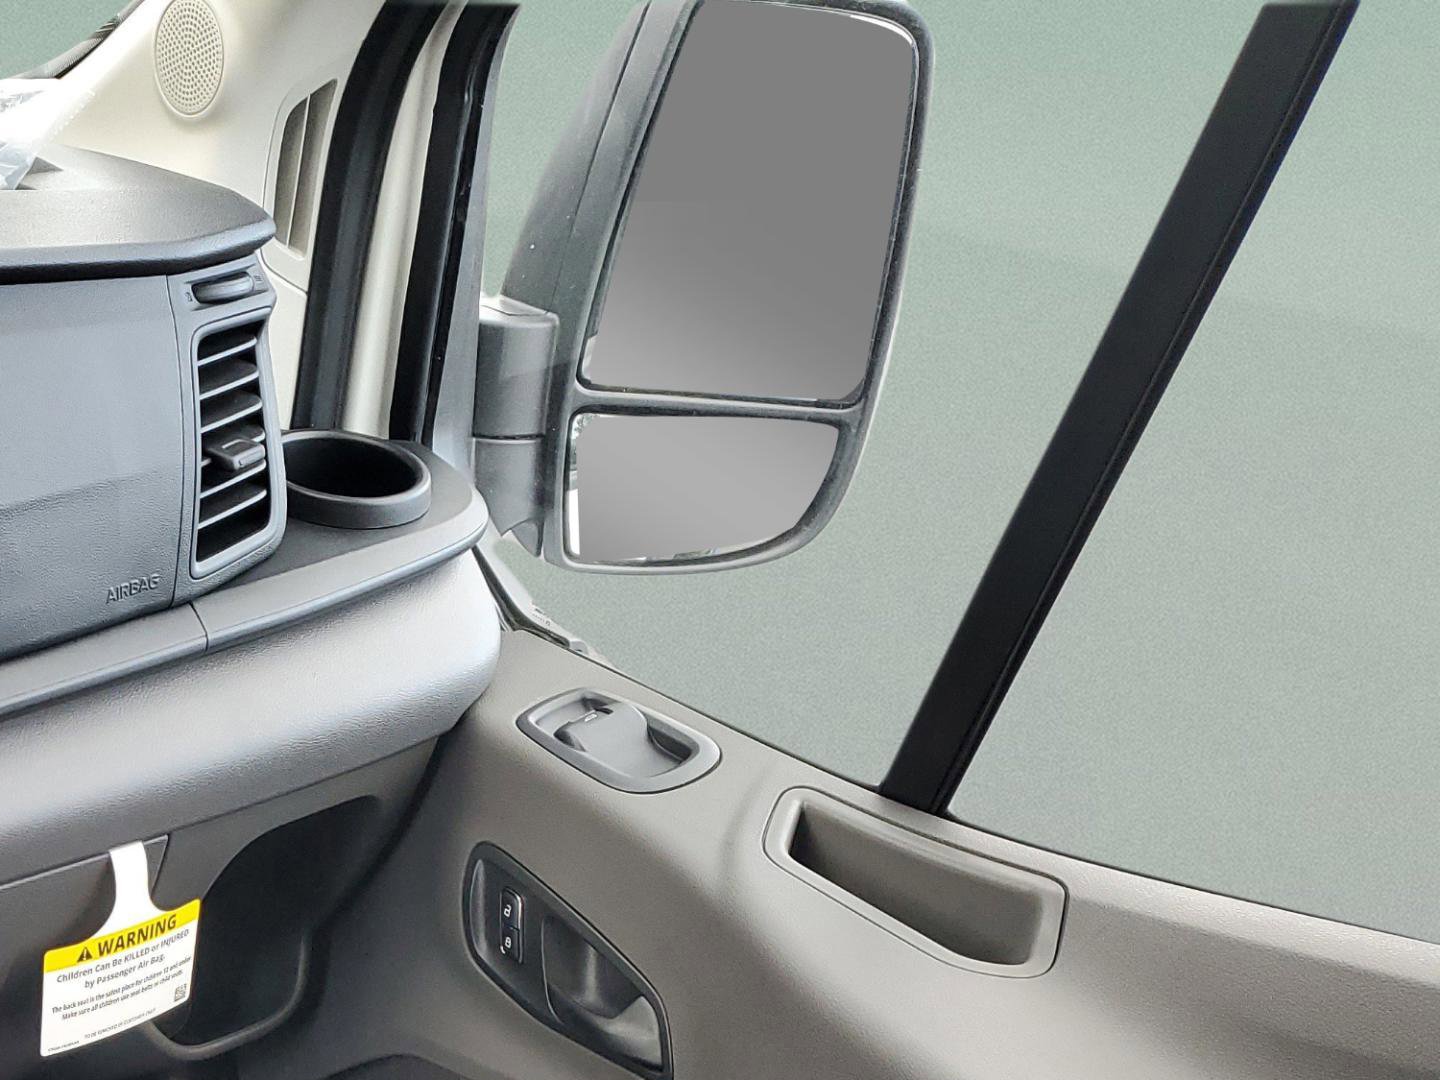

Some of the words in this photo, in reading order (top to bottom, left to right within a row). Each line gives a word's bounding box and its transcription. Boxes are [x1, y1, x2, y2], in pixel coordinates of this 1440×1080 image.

[105, 573, 162, 604] AIRBAG
[98, 914, 177, 958] WARNING
[56, 967, 93, 983] Children
[95, 962, 111, 973] Can
[112, 957, 123, 967] Be
[124, 947, 150, 963] KILLED
[151, 944, 159, 952] or
[160, 928, 190, 948] INJURED
[84, 978, 95, 989] by
[96, 965, 136, 985] Passenger
[138, 958, 149, 970] Air
[52, 1004, 62, 1014] The
[62, 1000, 76, 1011] back
[95, 992, 105, 1001] the
[121, 983, 136, 994] place
[62, 1010, 77, 1020] Make
